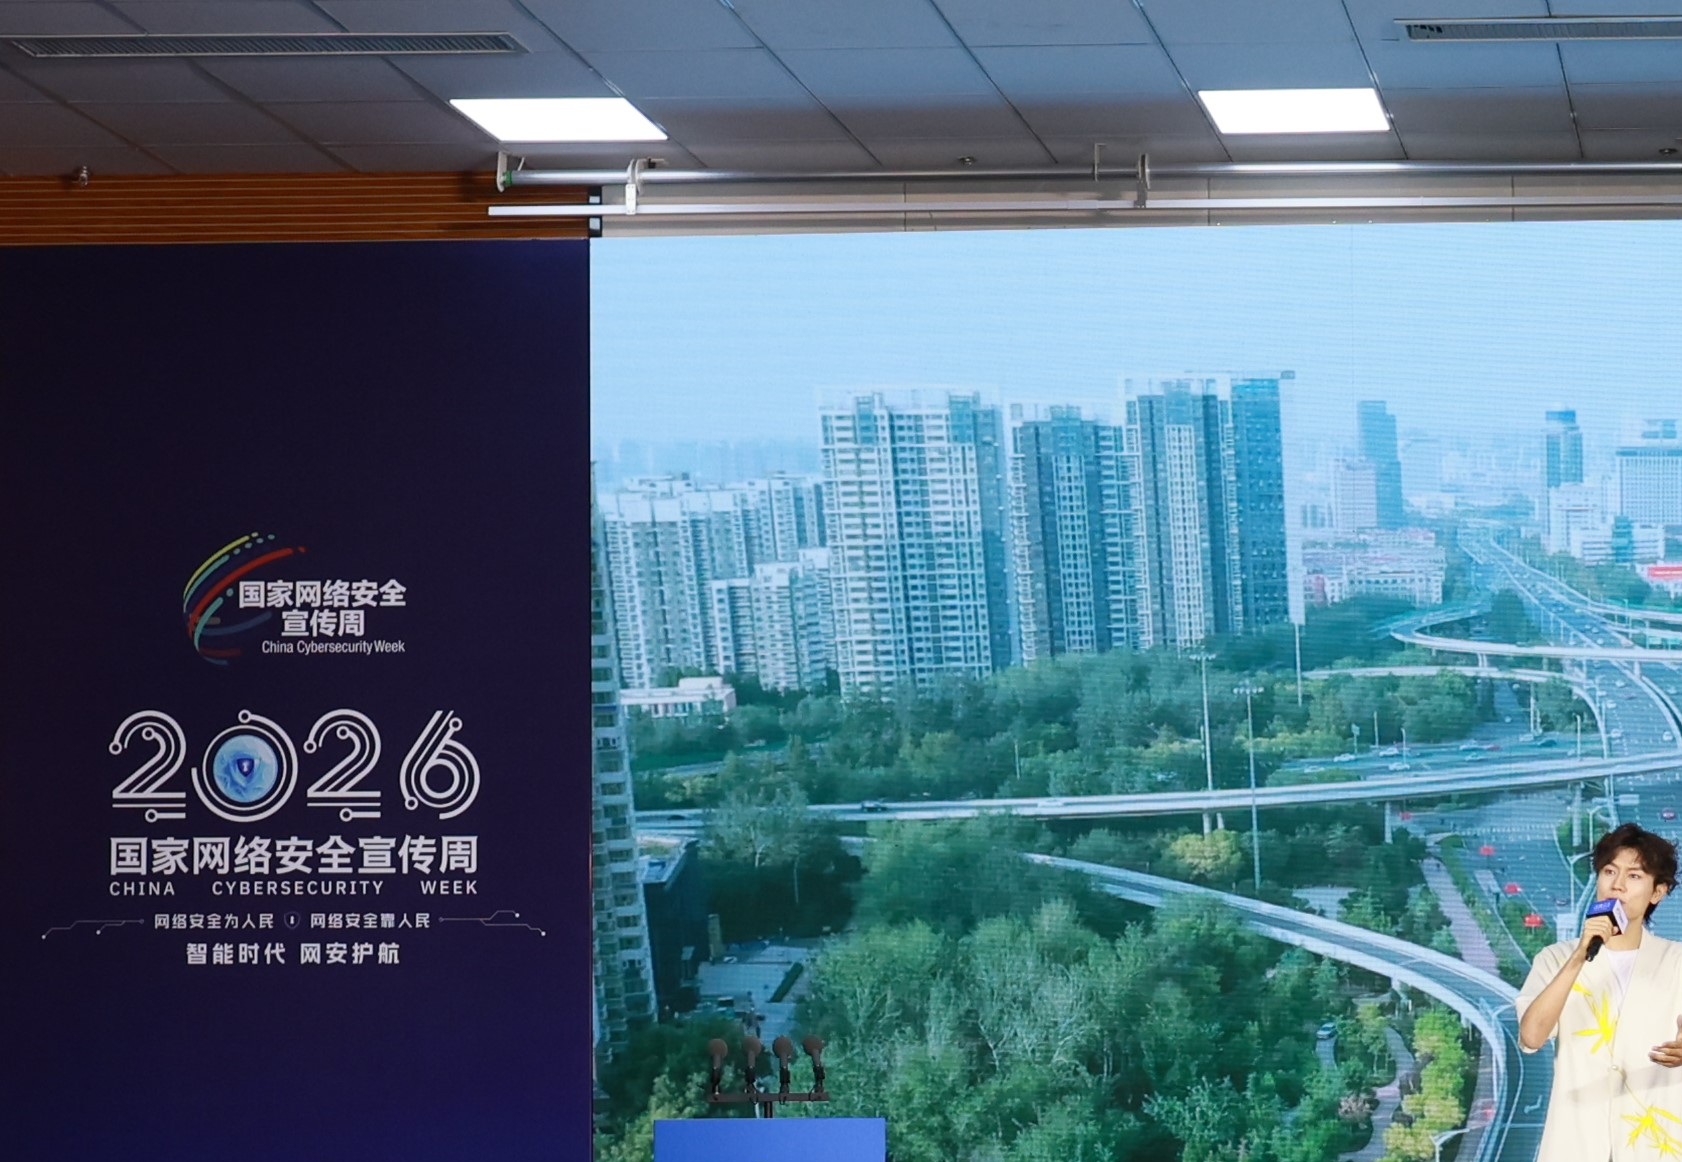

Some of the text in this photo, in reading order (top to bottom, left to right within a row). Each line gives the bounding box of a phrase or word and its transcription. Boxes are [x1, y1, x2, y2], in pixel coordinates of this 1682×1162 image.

[239, 580, 406, 608] 国家网络安全
[281, 610, 364, 636] 宣传周
[262, 638, 405, 655] China Cybersecurity Week
[109, 709, 480, 822] 2026
[110, 835, 478, 876] 国家网络安全宣传周
[109, 879, 478, 896] CHINA CYBERSECURITY WEEK
[154, 912, 431, 929] 网络安全为人民 网络安全靠人民
[186, 942, 400, 964] 智能时代 网安护航
